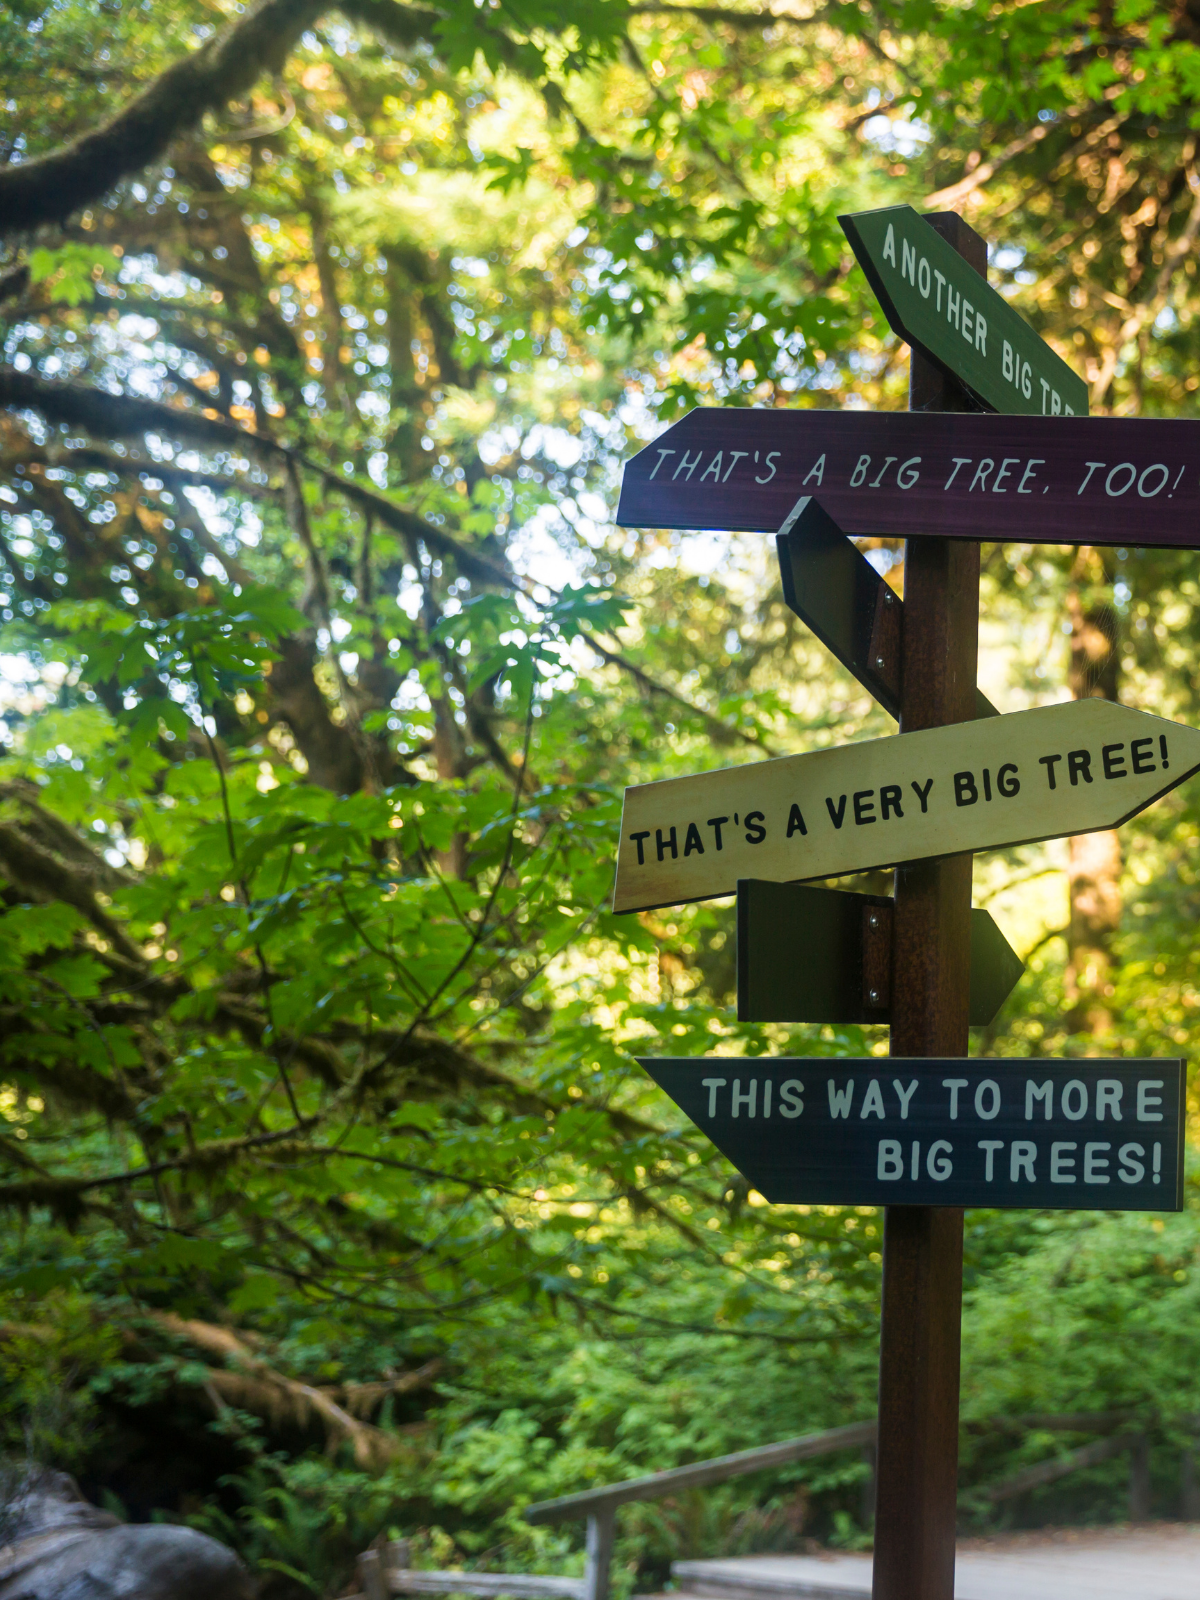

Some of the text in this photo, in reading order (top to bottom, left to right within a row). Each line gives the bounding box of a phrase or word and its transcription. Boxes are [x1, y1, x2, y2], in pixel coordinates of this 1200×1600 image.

[882, 223, 988, 357] ANOTHER
[1002, 339, 1032, 400] BIG
[649, 449, 1186, 499] THAT'S A BIG TREE, TOO!
[629, 734, 1170, 865] THAT'S A VERY BIG TREE!
[701, 1078, 1164, 1121] THIS WAY TO MORE
[877, 1140, 1162, 1184] BIG TREES!
